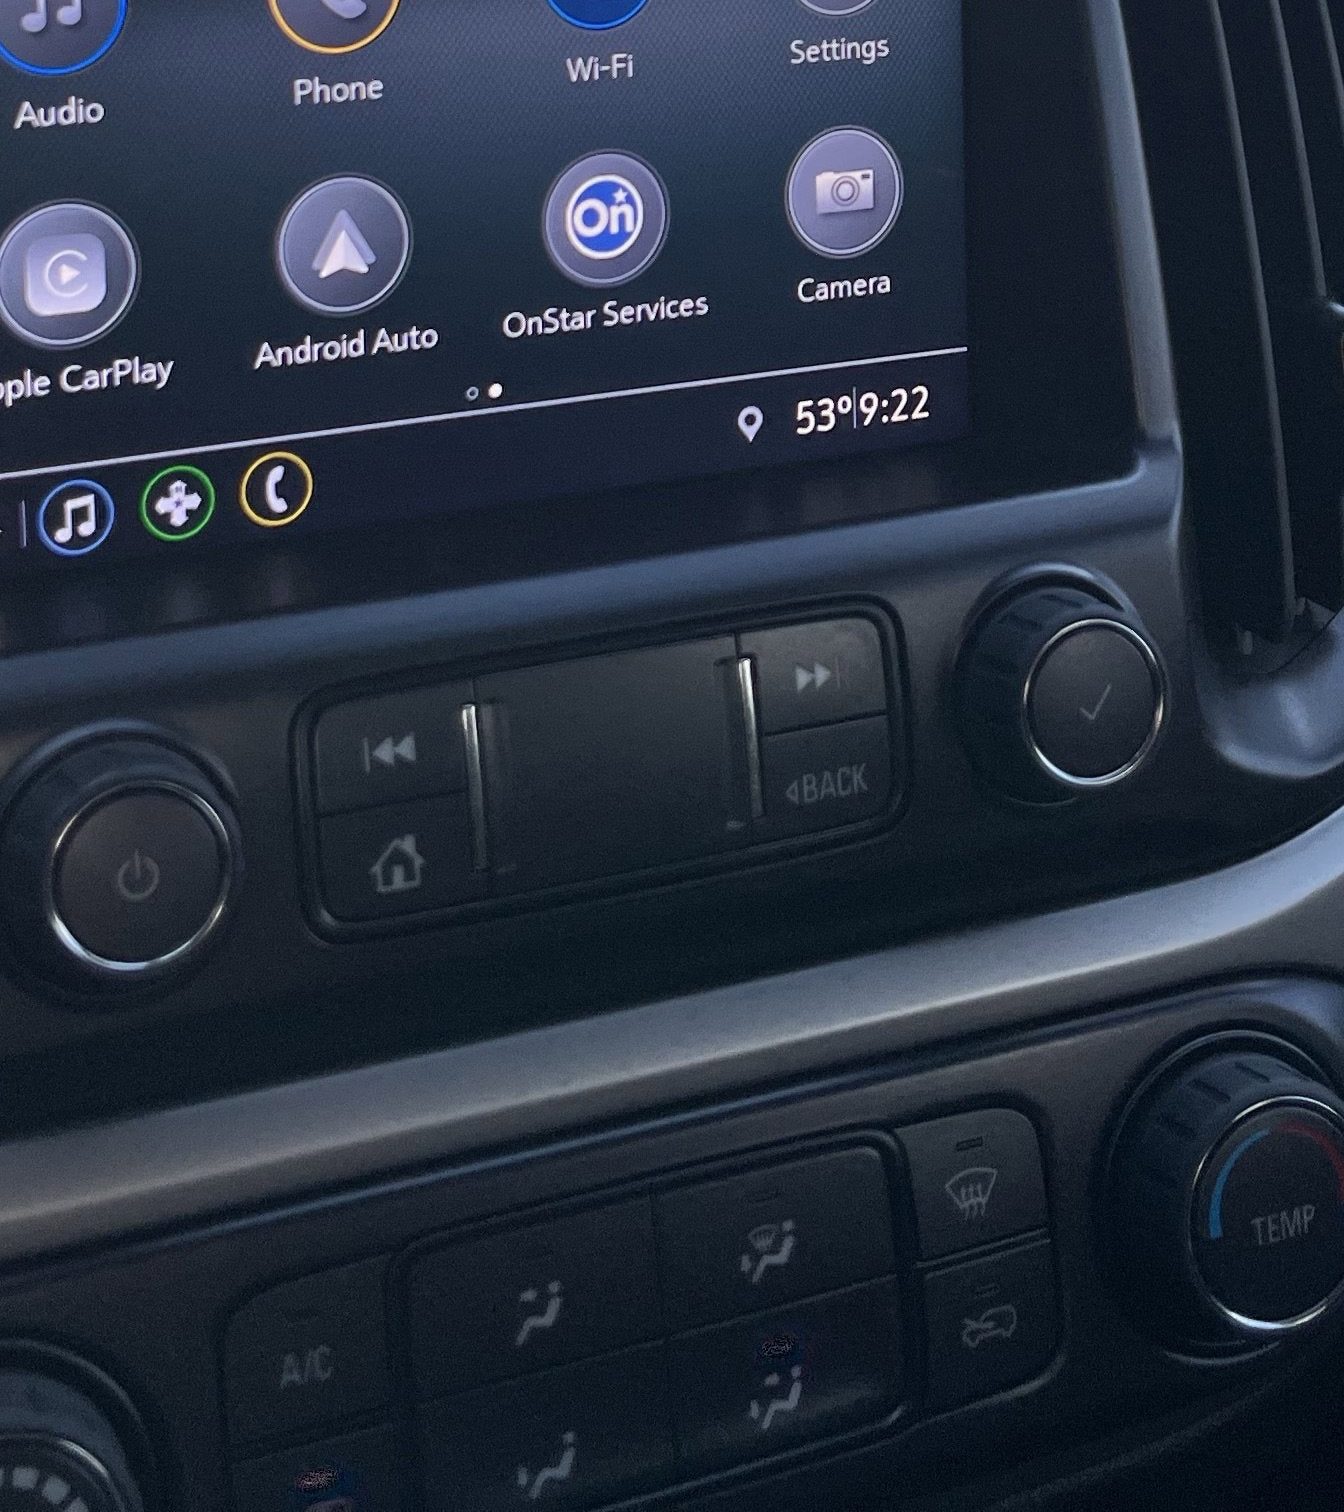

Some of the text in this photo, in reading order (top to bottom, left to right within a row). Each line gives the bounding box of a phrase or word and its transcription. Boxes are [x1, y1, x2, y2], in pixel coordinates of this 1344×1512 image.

[566, 54, 634, 82] Wi-Fi
[789, 34, 889, 66] Settings
[293, 73, 384, 105] Phone
[13, 97, 104, 129] Audio
[796, 271, 891, 303] Camera
[503, 293, 708, 340] OnStar Services
[254, 323, 438, 370] Android Auto
[58, 355, 174, 398] CarPlay
[858, 386, 928, 427] 9:22
[803, 763, 868, 802] BACK
[1252, 1206, 1317, 1246] TEMP
[280, 1346, 332, 1388] A/C
